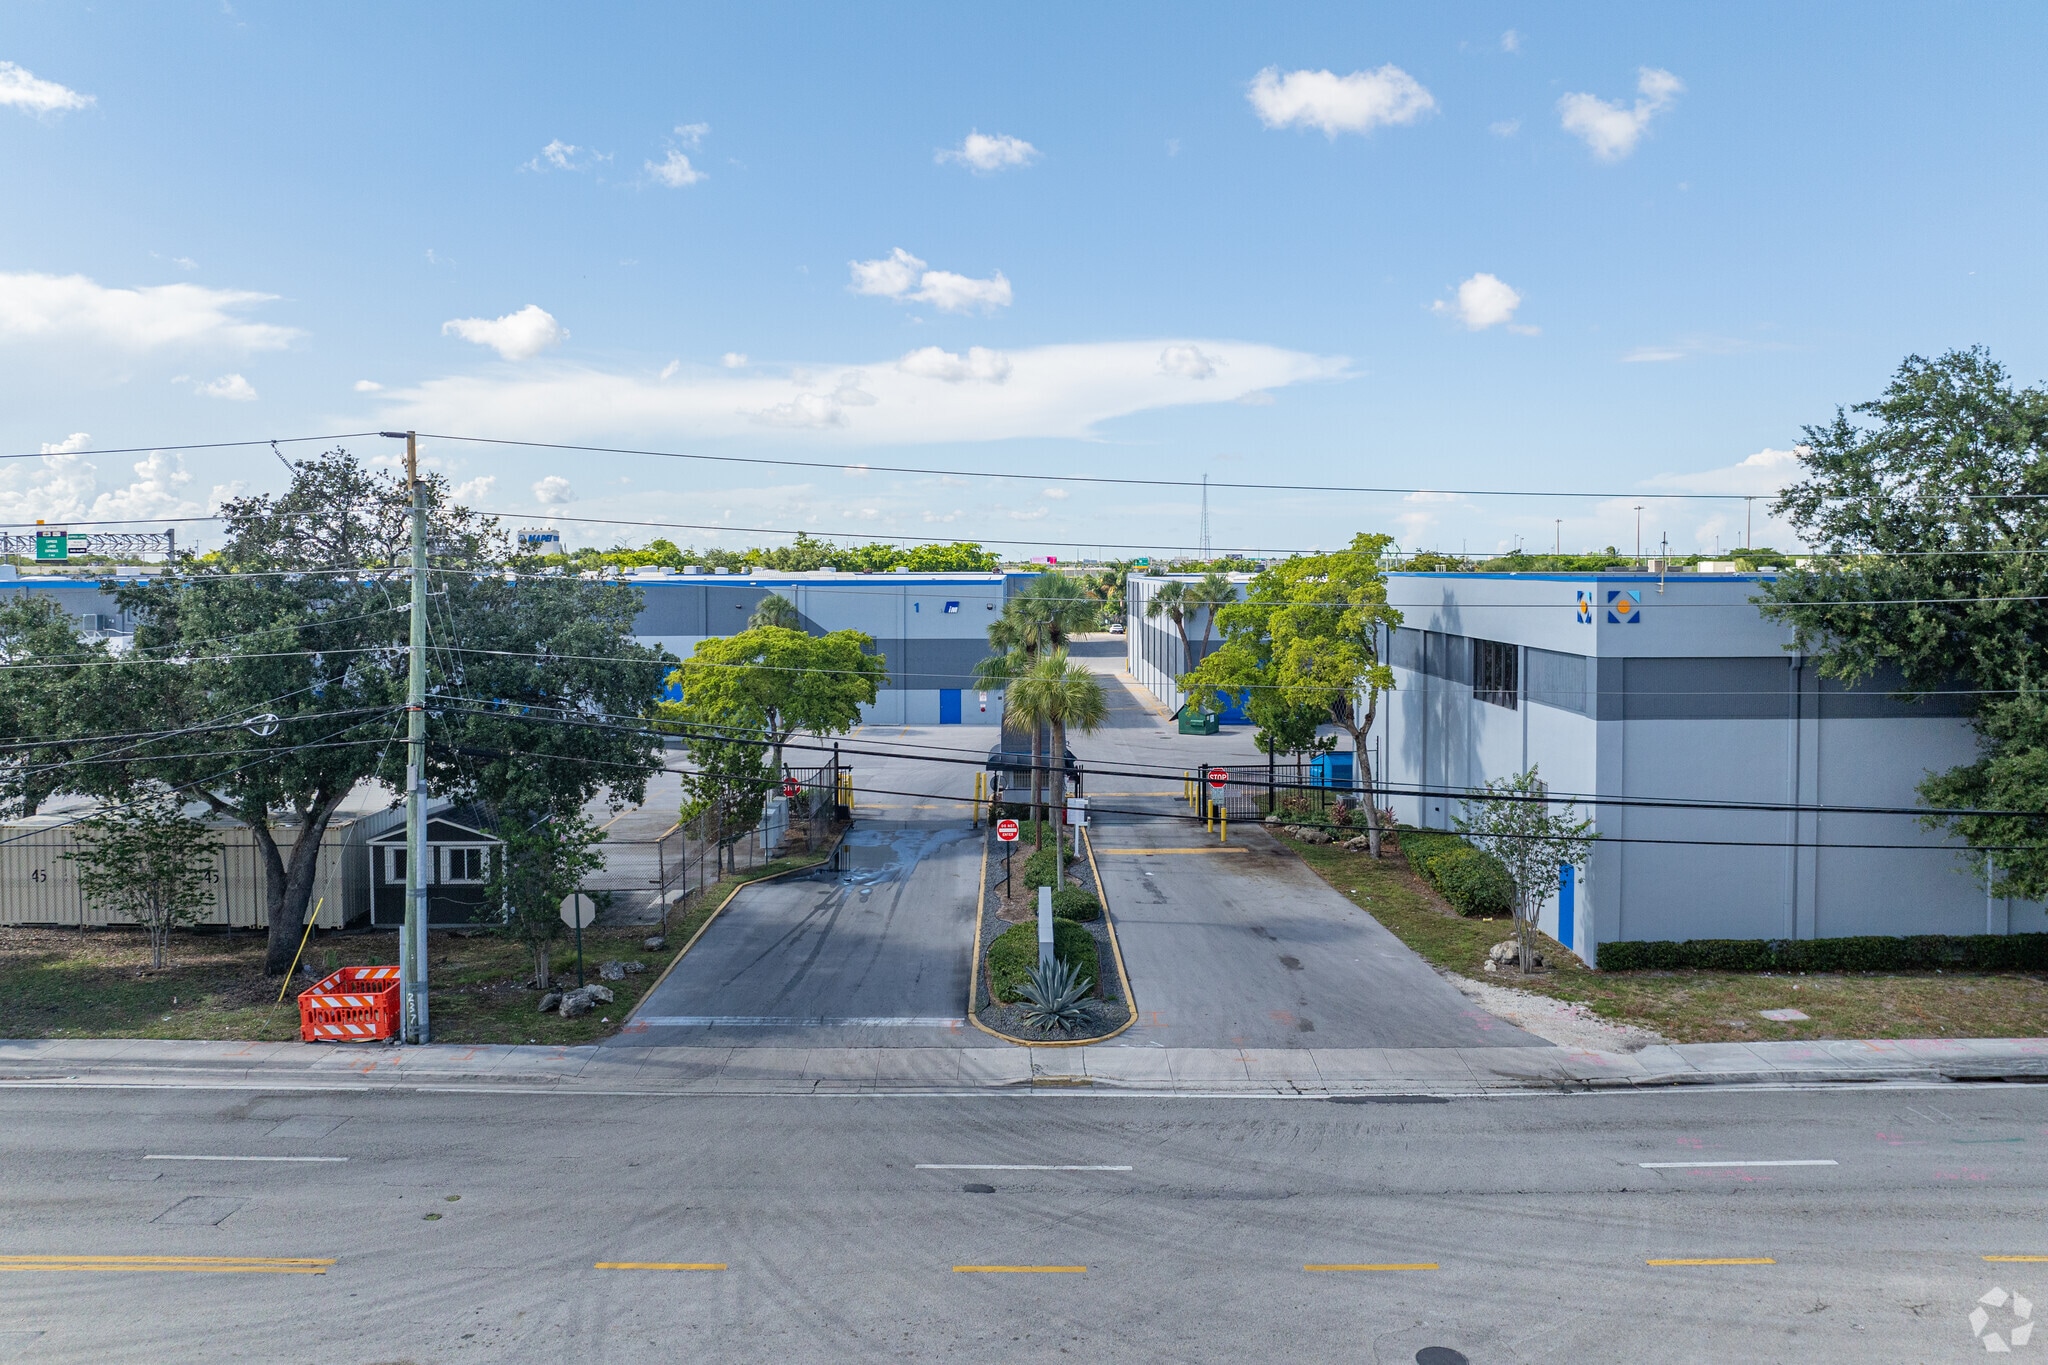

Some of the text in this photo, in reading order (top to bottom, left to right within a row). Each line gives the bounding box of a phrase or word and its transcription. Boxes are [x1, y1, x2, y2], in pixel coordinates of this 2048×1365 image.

[527, 534, 553, 542] MAPEI
[914, 602, 919, 613] 1
[1209, 773, 1227, 781] STOP
[32, 869, 47, 883] 45
[407, 993, 417, 1024] 237
